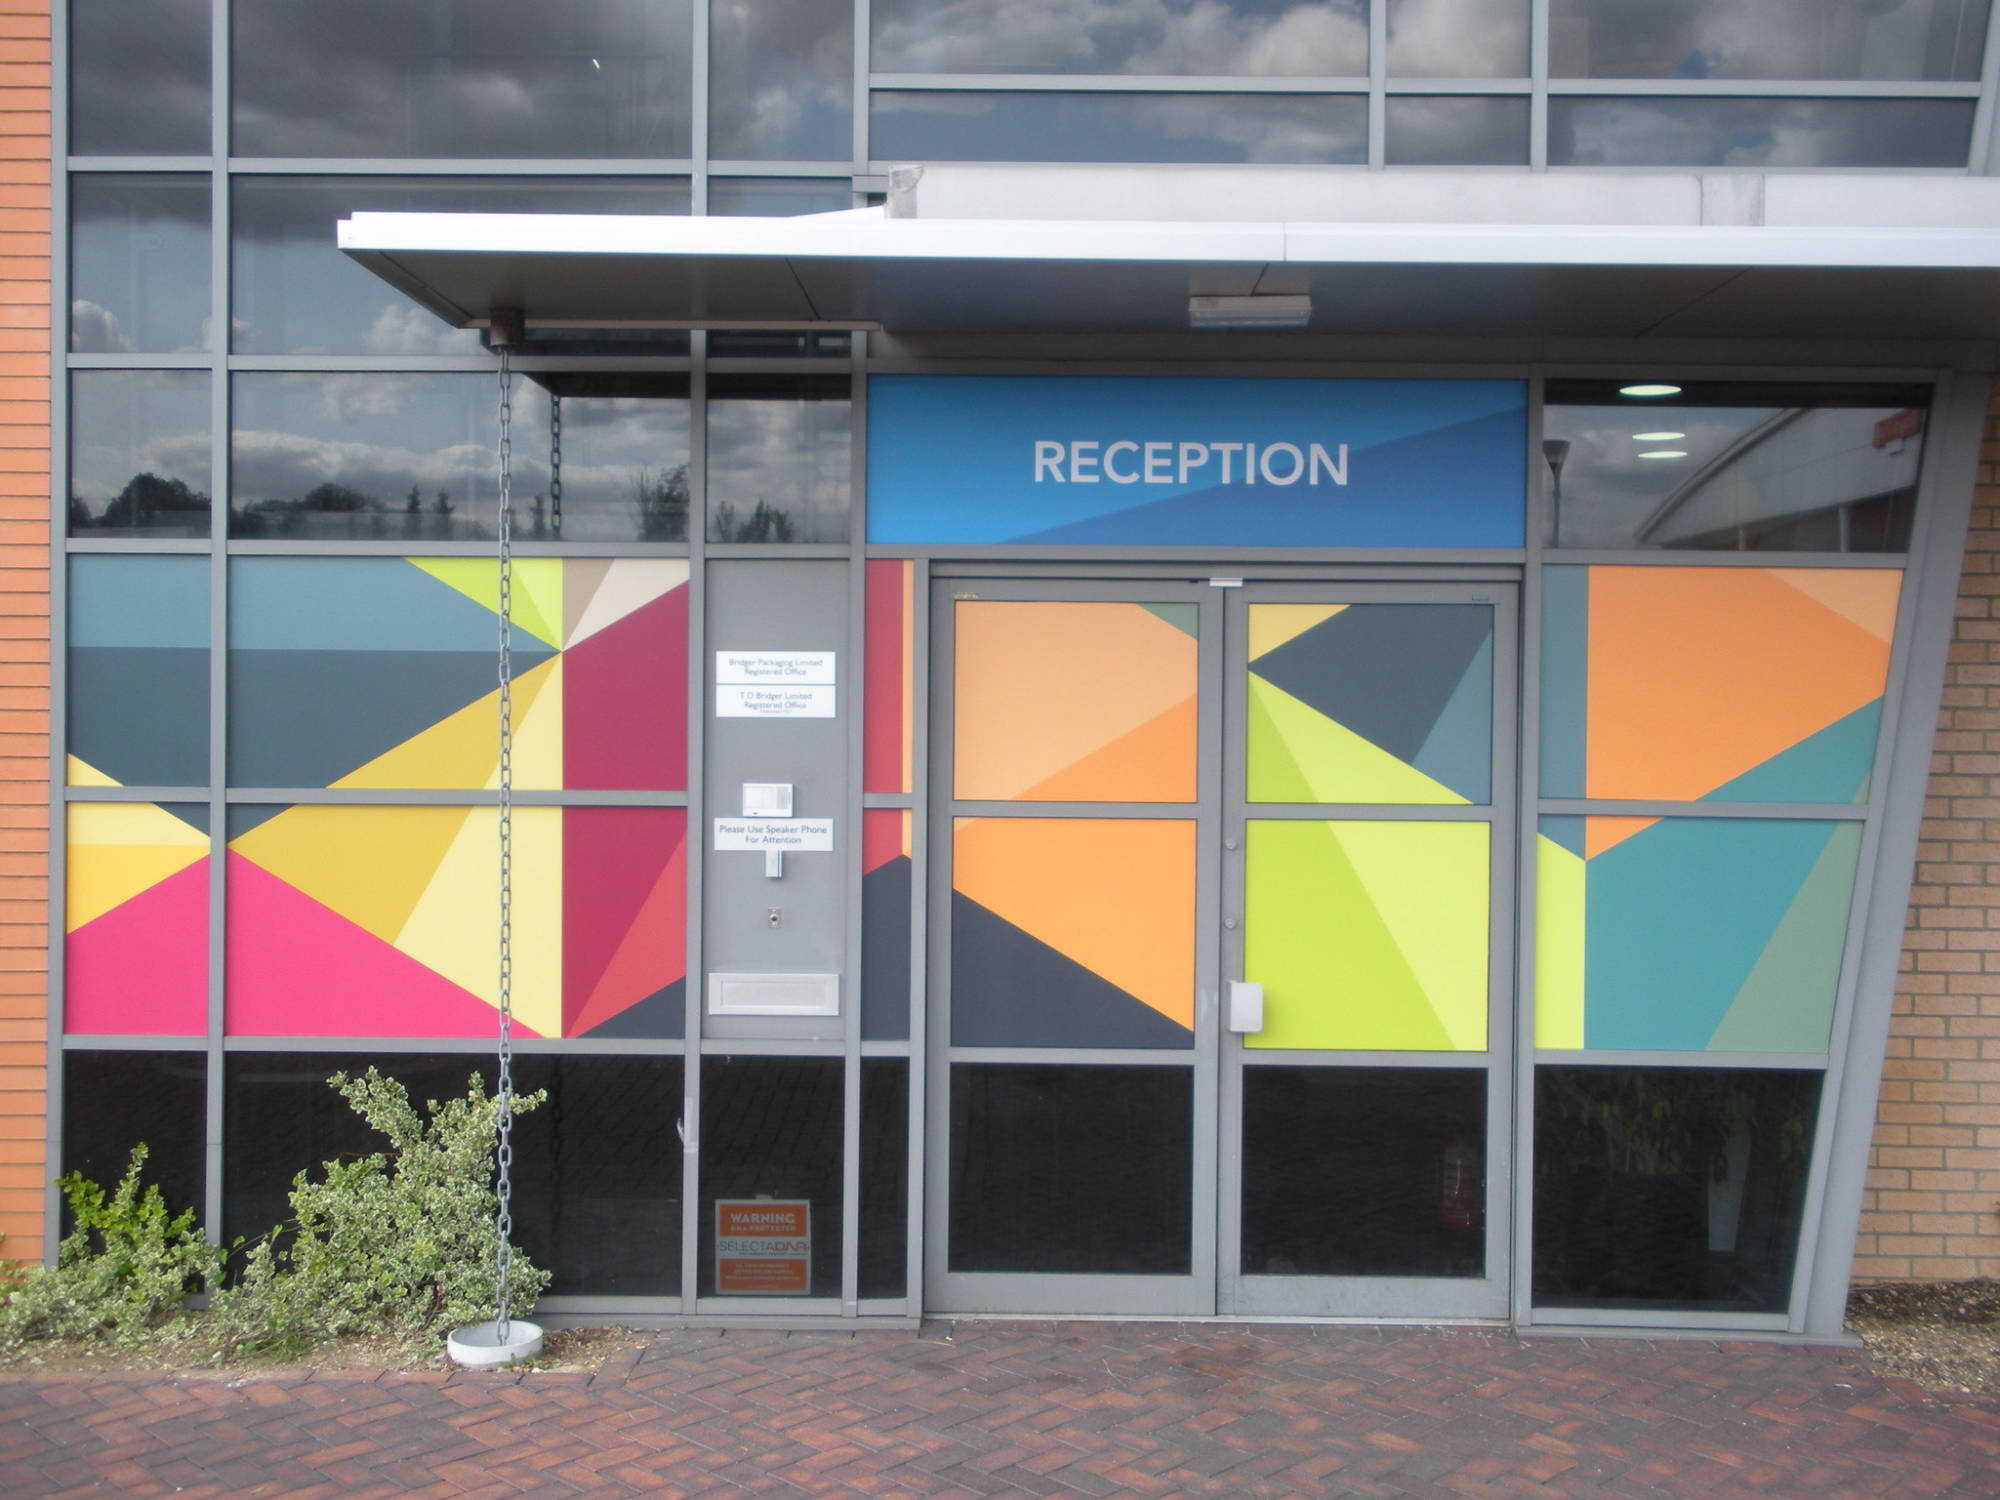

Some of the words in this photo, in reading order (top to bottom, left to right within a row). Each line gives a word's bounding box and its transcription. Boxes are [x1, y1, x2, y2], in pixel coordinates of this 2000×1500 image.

[1034, 440, 1348, 486] RECEPTION
[728, 658, 755, 668] Bridger
[758, 658, 793, 668] Packaging
[795, 658, 823, 667] Limited
[744, 668, 783, 677] Registered
[784, 668, 807, 676] Office
[740, 691, 745, 700] T
[756, 691, 782, 702] Bridger
[784, 691, 812, 700] Limited
[744, 701, 783, 710] Registered
[784, 701, 807, 709] Office
[719, 824, 745, 833] Please
[747, 824, 763, 833] Use
[765, 824, 798, 835] Speaker
[801, 825, 827, 834] Phone
[745, 836, 759, 844] For
[762, 836, 801, 844] Attention
[730, 1213, 796, 1224] WARNING
